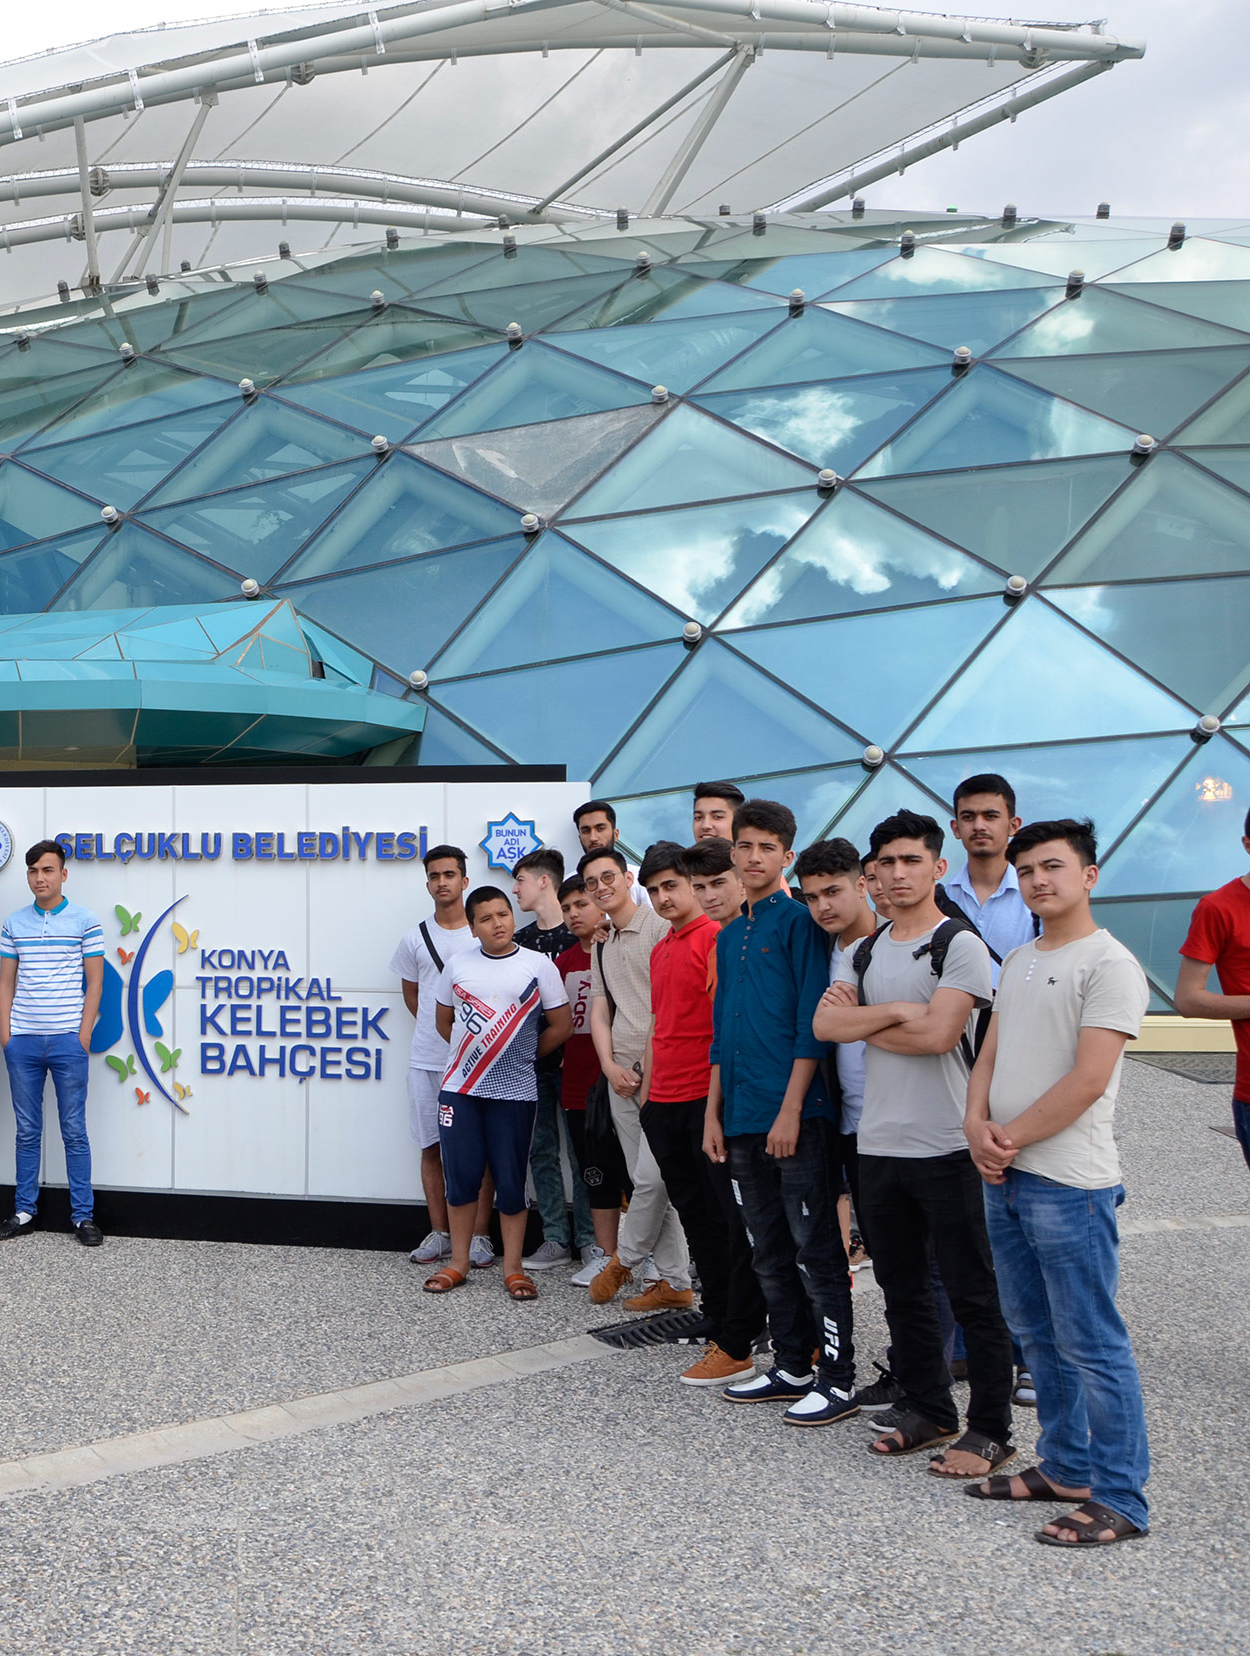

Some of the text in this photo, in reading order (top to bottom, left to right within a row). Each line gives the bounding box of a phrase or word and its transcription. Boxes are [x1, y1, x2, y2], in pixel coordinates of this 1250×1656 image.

[55, 825, 428, 863] SELÇUKLU BELEDİYESİ
[495, 829, 527, 837] BUNUN
[504, 838, 520, 846] ADI
[496, 847, 527, 863] AŞK
[201, 949, 291, 971] KONYA
[195, 976, 343, 1001] TROPİKAL
[200, 1003, 390, 1041] KELEBEK
[461, 1003, 518, 1079] ACTIVE TRAINING
[200, 1042, 383, 1084] BAHÇESİ
[823, 1315, 840, 1361] UFC
